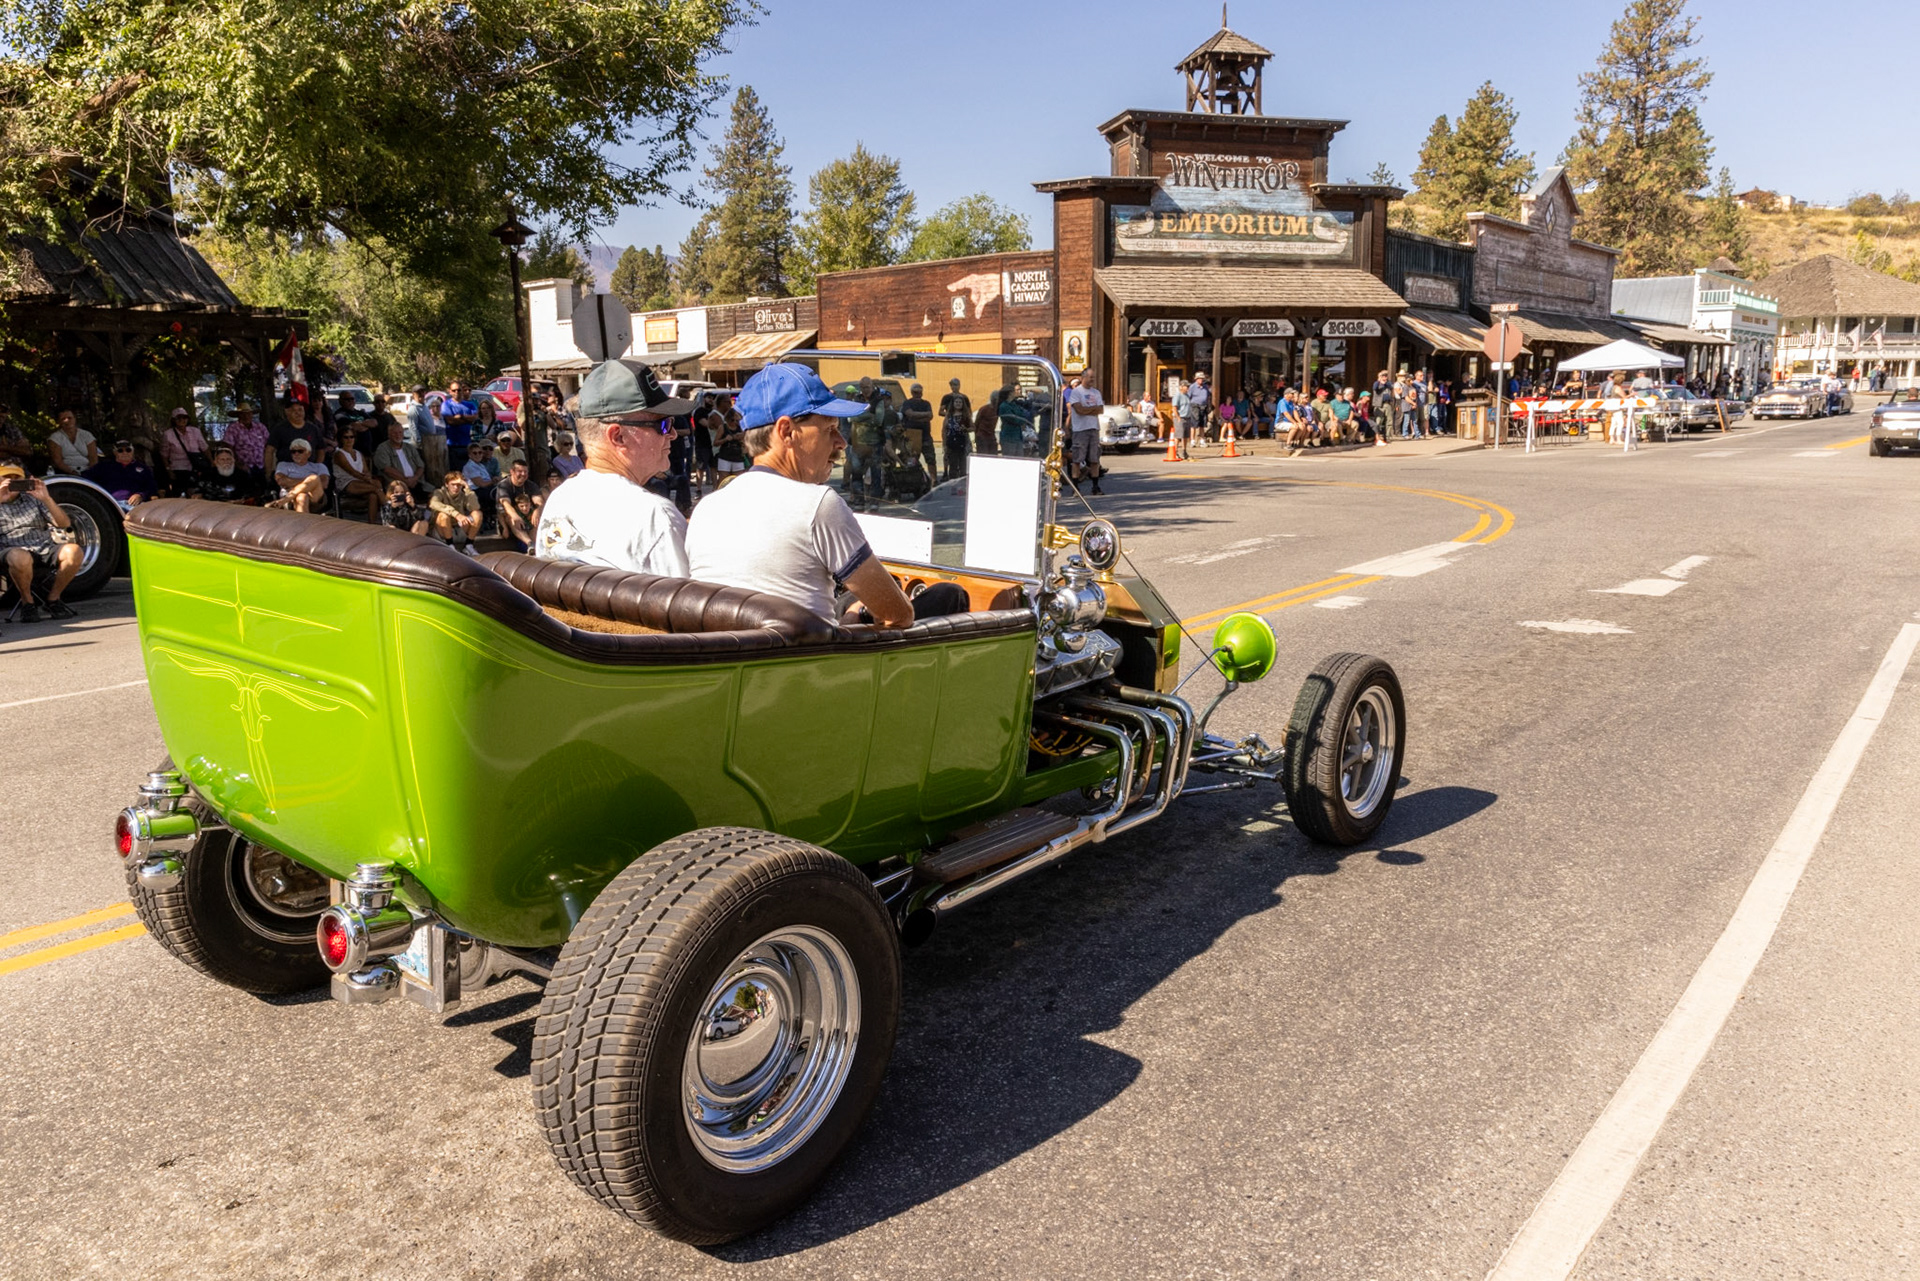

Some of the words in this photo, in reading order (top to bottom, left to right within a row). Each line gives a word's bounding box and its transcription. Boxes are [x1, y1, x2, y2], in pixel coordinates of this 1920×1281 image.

[1194, 153, 1250, 163] WELCOME
[1256, 156, 1273, 164] TO
[1165, 152, 1299, 194] WINTHROP
[1160, 212, 1309, 236] EMPORIUM
[1014, 270, 1047, 282] NORTH
[1011, 281, 1050, 292] CASCADES
[1014, 291, 1047, 303] HIWAY
[754, 308, 793, 325] Oliver's
[1146, 320, 1187, 336] MILK
[1238, 321, 1279, 336] BREAD
[1328, 321, 1365, 335] EGGS
